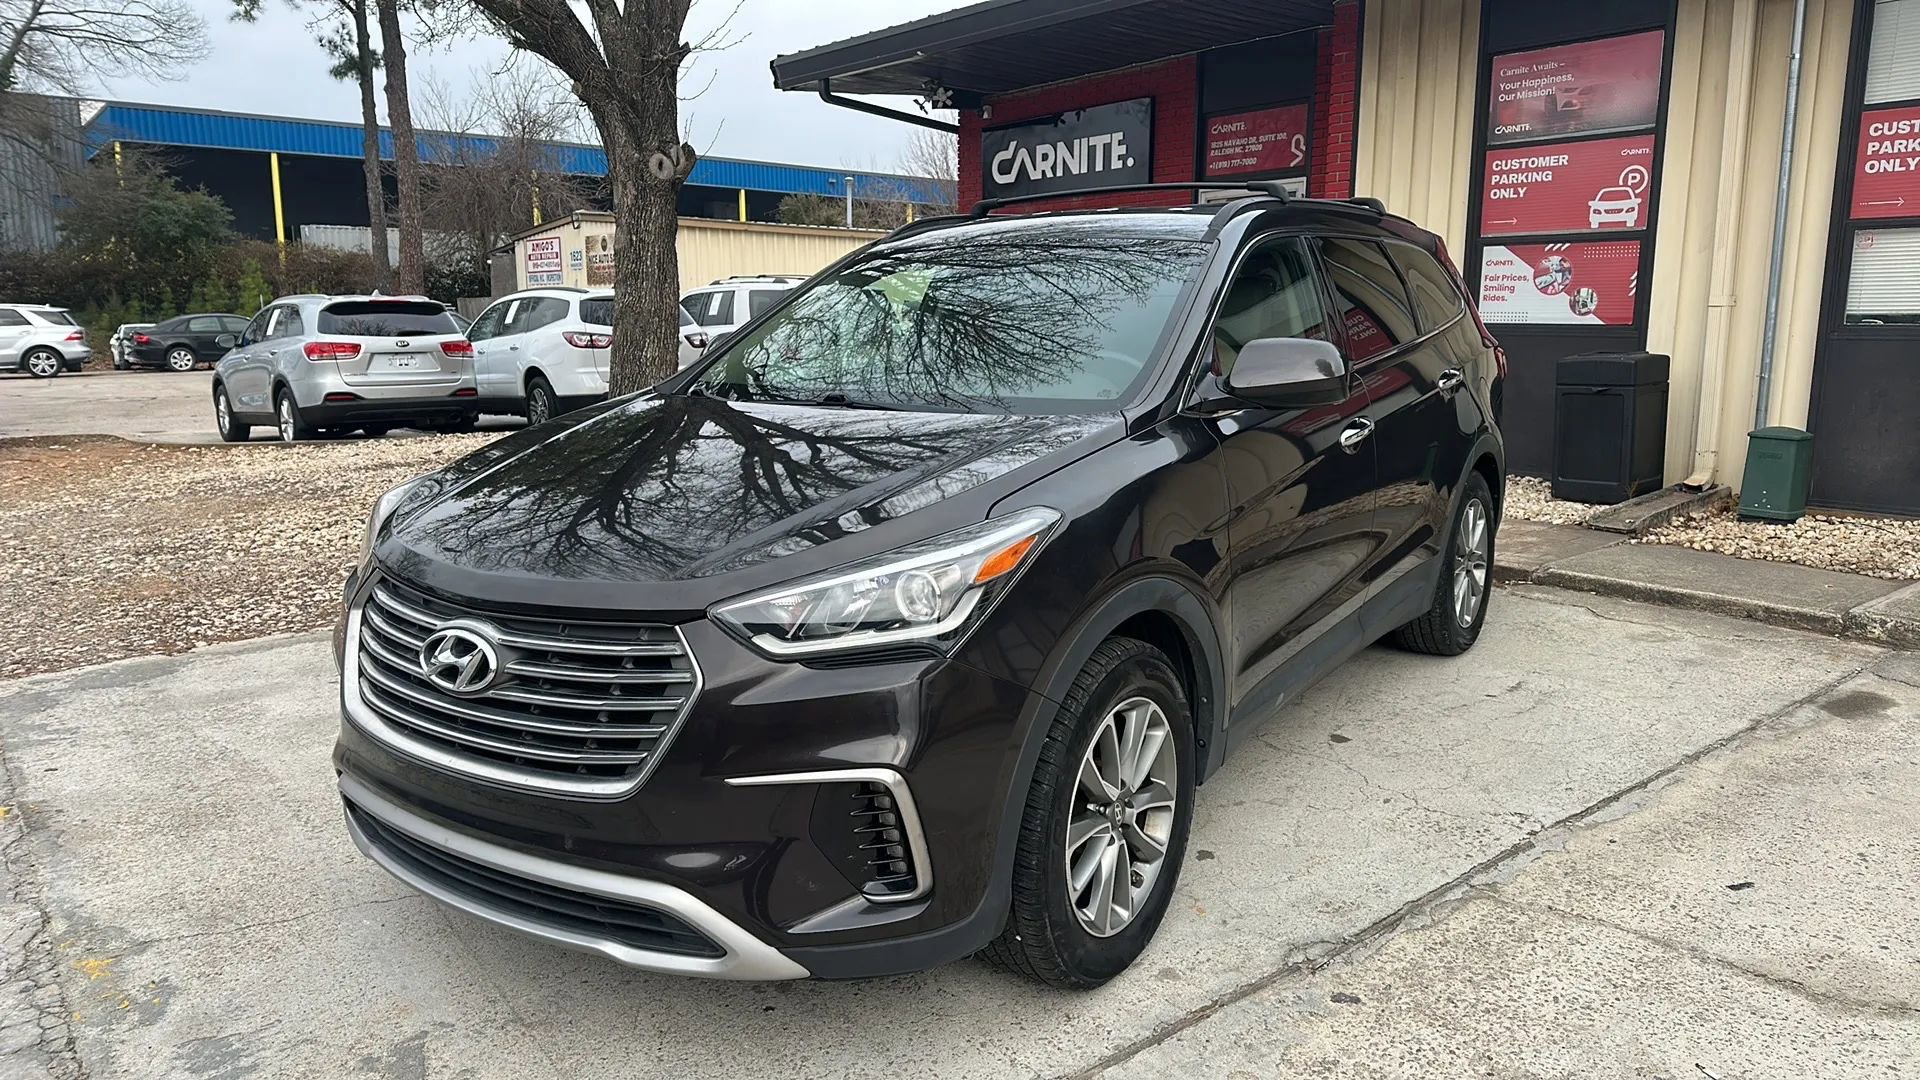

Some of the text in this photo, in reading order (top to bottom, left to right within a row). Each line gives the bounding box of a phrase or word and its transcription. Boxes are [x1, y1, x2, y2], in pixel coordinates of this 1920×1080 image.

[1500, 67, 1530, 77] Carnite
[1530, 61, 1558, 72] Awaits
[1500, 73, 1575, 91] Your Happiness,
[1498, 86, 1556, 102] Our Mission!
[1258, 134, 1276, 143] SUITE
[1210, 148, 1234, 157] RALEIGH
[1867, 138, 1920, 155] PARK
[991, 131, 1135, 185] CARNITE.
[1492, 154, 1569, 171] CUSTOMER
[1864, 157, 1920, 173] ONLY
[1491, 171, 1552, 185] PARKING
[1628, 173, 1641, 186] P
[1490, 187, 1527, 199] ONLY
[1484, 273, 1529, 282] Fair Prices,
[1483, 284, 1515, 294] Smiling
[1483, 294, 1508, 302] Rides.
